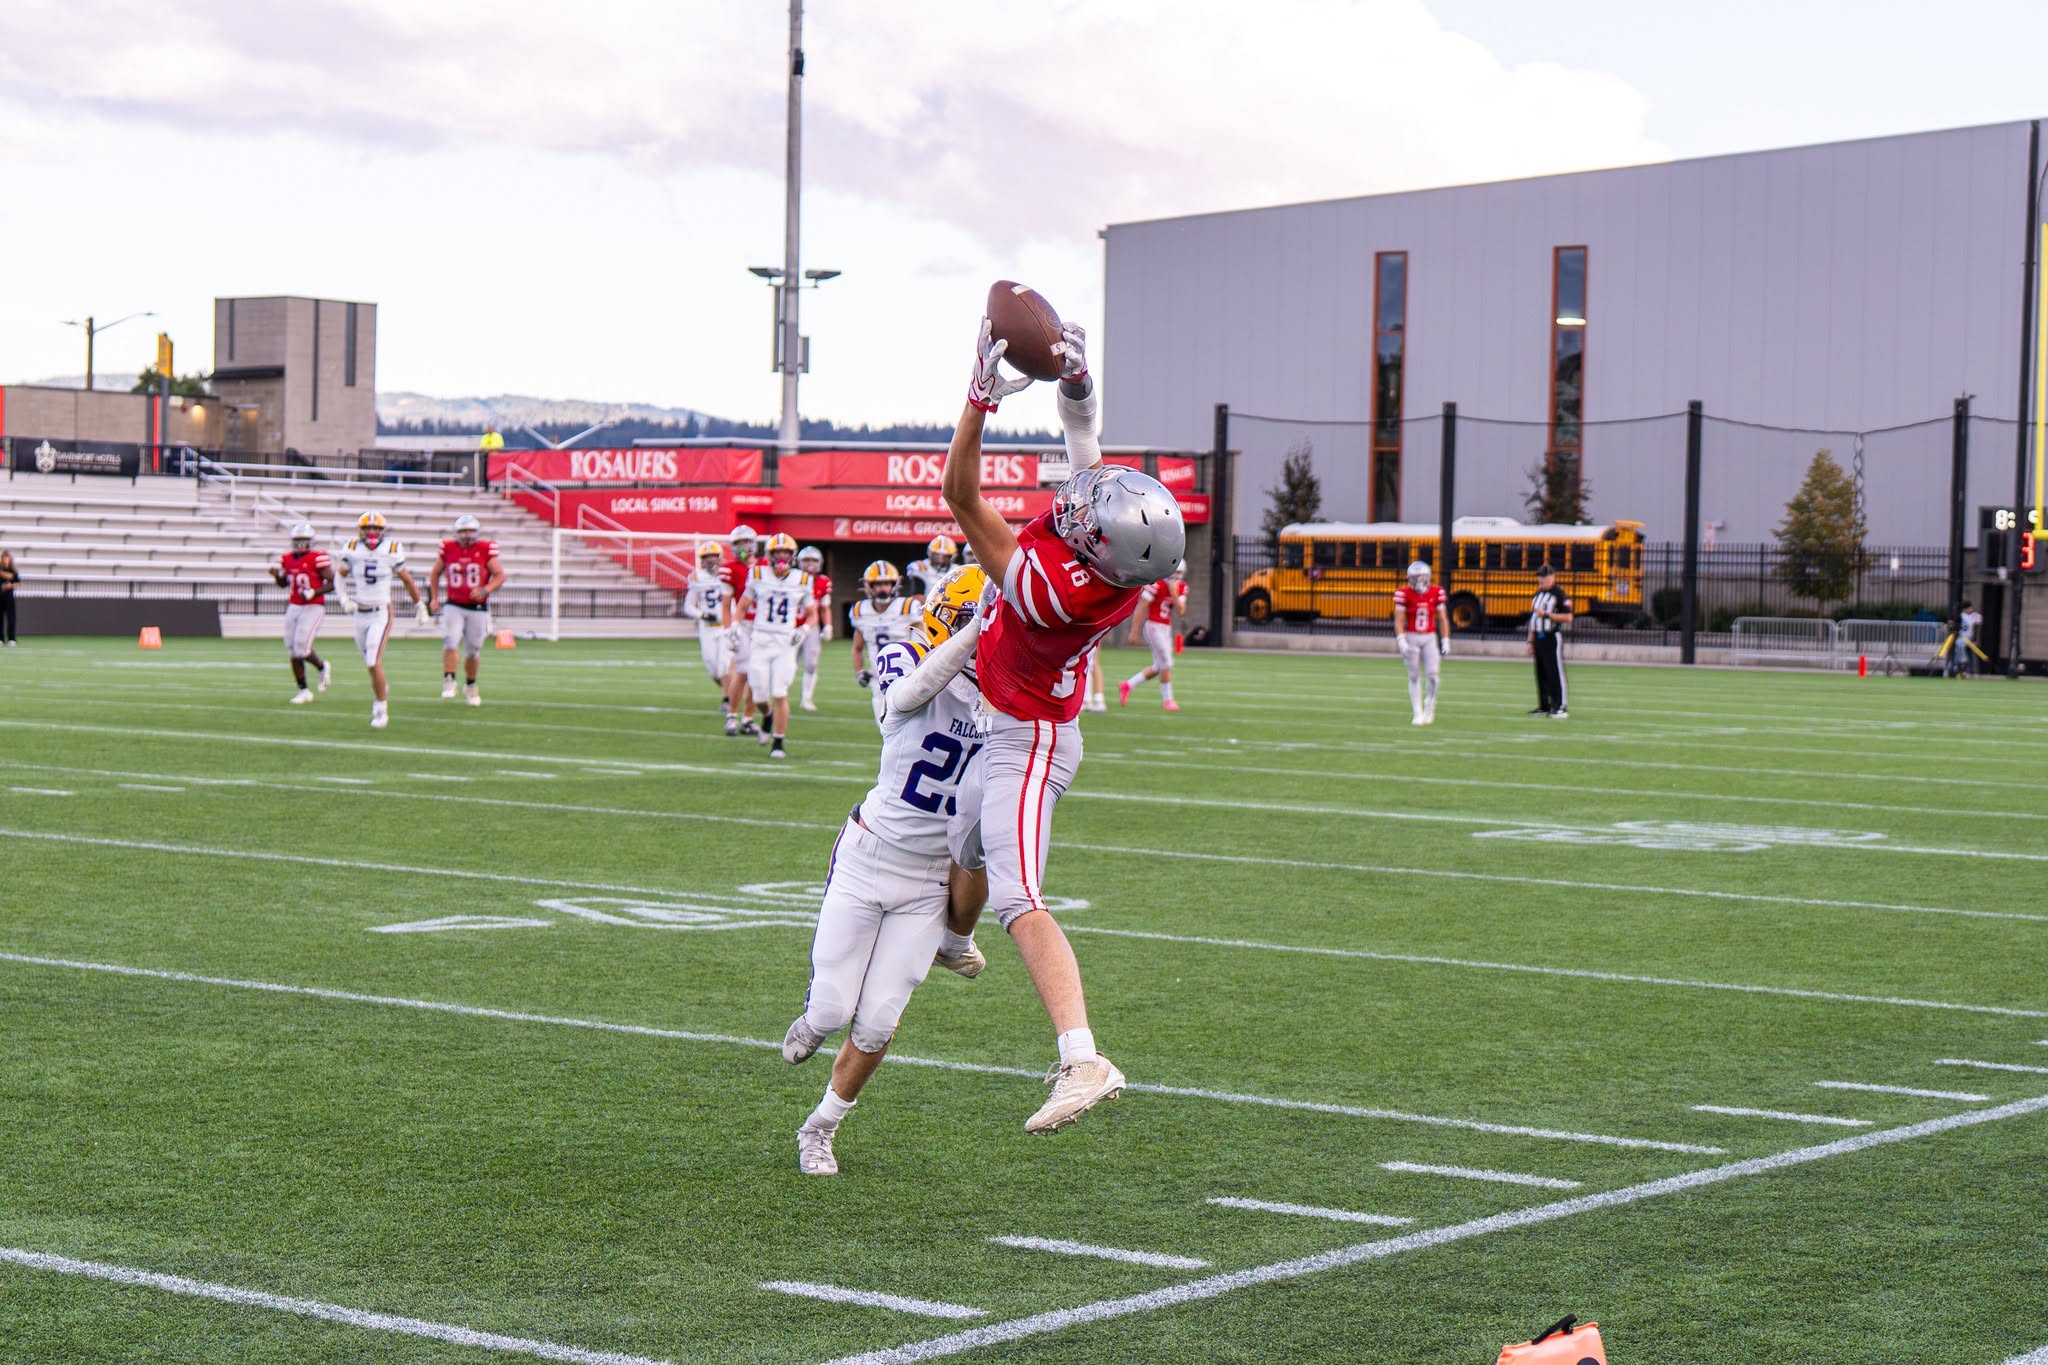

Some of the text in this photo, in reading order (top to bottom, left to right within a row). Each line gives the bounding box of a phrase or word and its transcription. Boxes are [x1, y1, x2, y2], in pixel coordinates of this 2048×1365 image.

[570, 450, 678, 479] ROSAUERS
[887, 455, 1025, 484] ROSERS
[611, 498, 648, 513] LOCAL
[651, 498, 686, 512] SINCE
[688, 497, 717, 511] 1934
[886, 495, 936, 510] LOCAL
[852, 520, 911, 534] OFFICIAL
[2020, 531, 2036, 569] 3
[364, 566, 377, 584] 5
[448, 563, 480, 588] 68
[1061, 559, 1092, 587] 18
[767, 596, 789, 624] 14
[877, 652, 904, 677] 25
